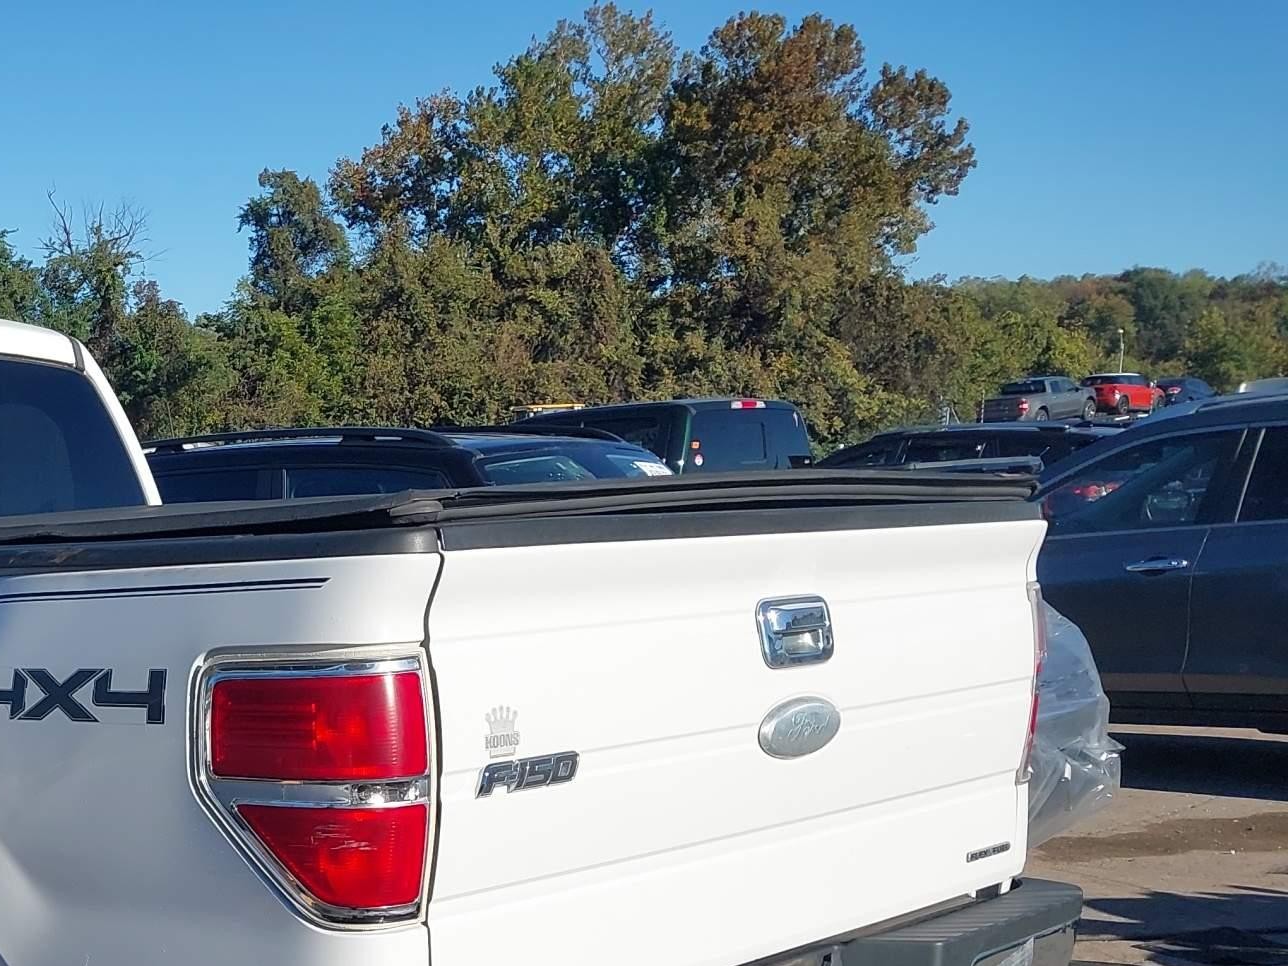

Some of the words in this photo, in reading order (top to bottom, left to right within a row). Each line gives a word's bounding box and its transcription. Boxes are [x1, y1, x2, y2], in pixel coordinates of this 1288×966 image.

[485, 731, 520, 750] KOONS
[787, 710, 831, 742] Ford
[475, 751, 580, 799] F-150
